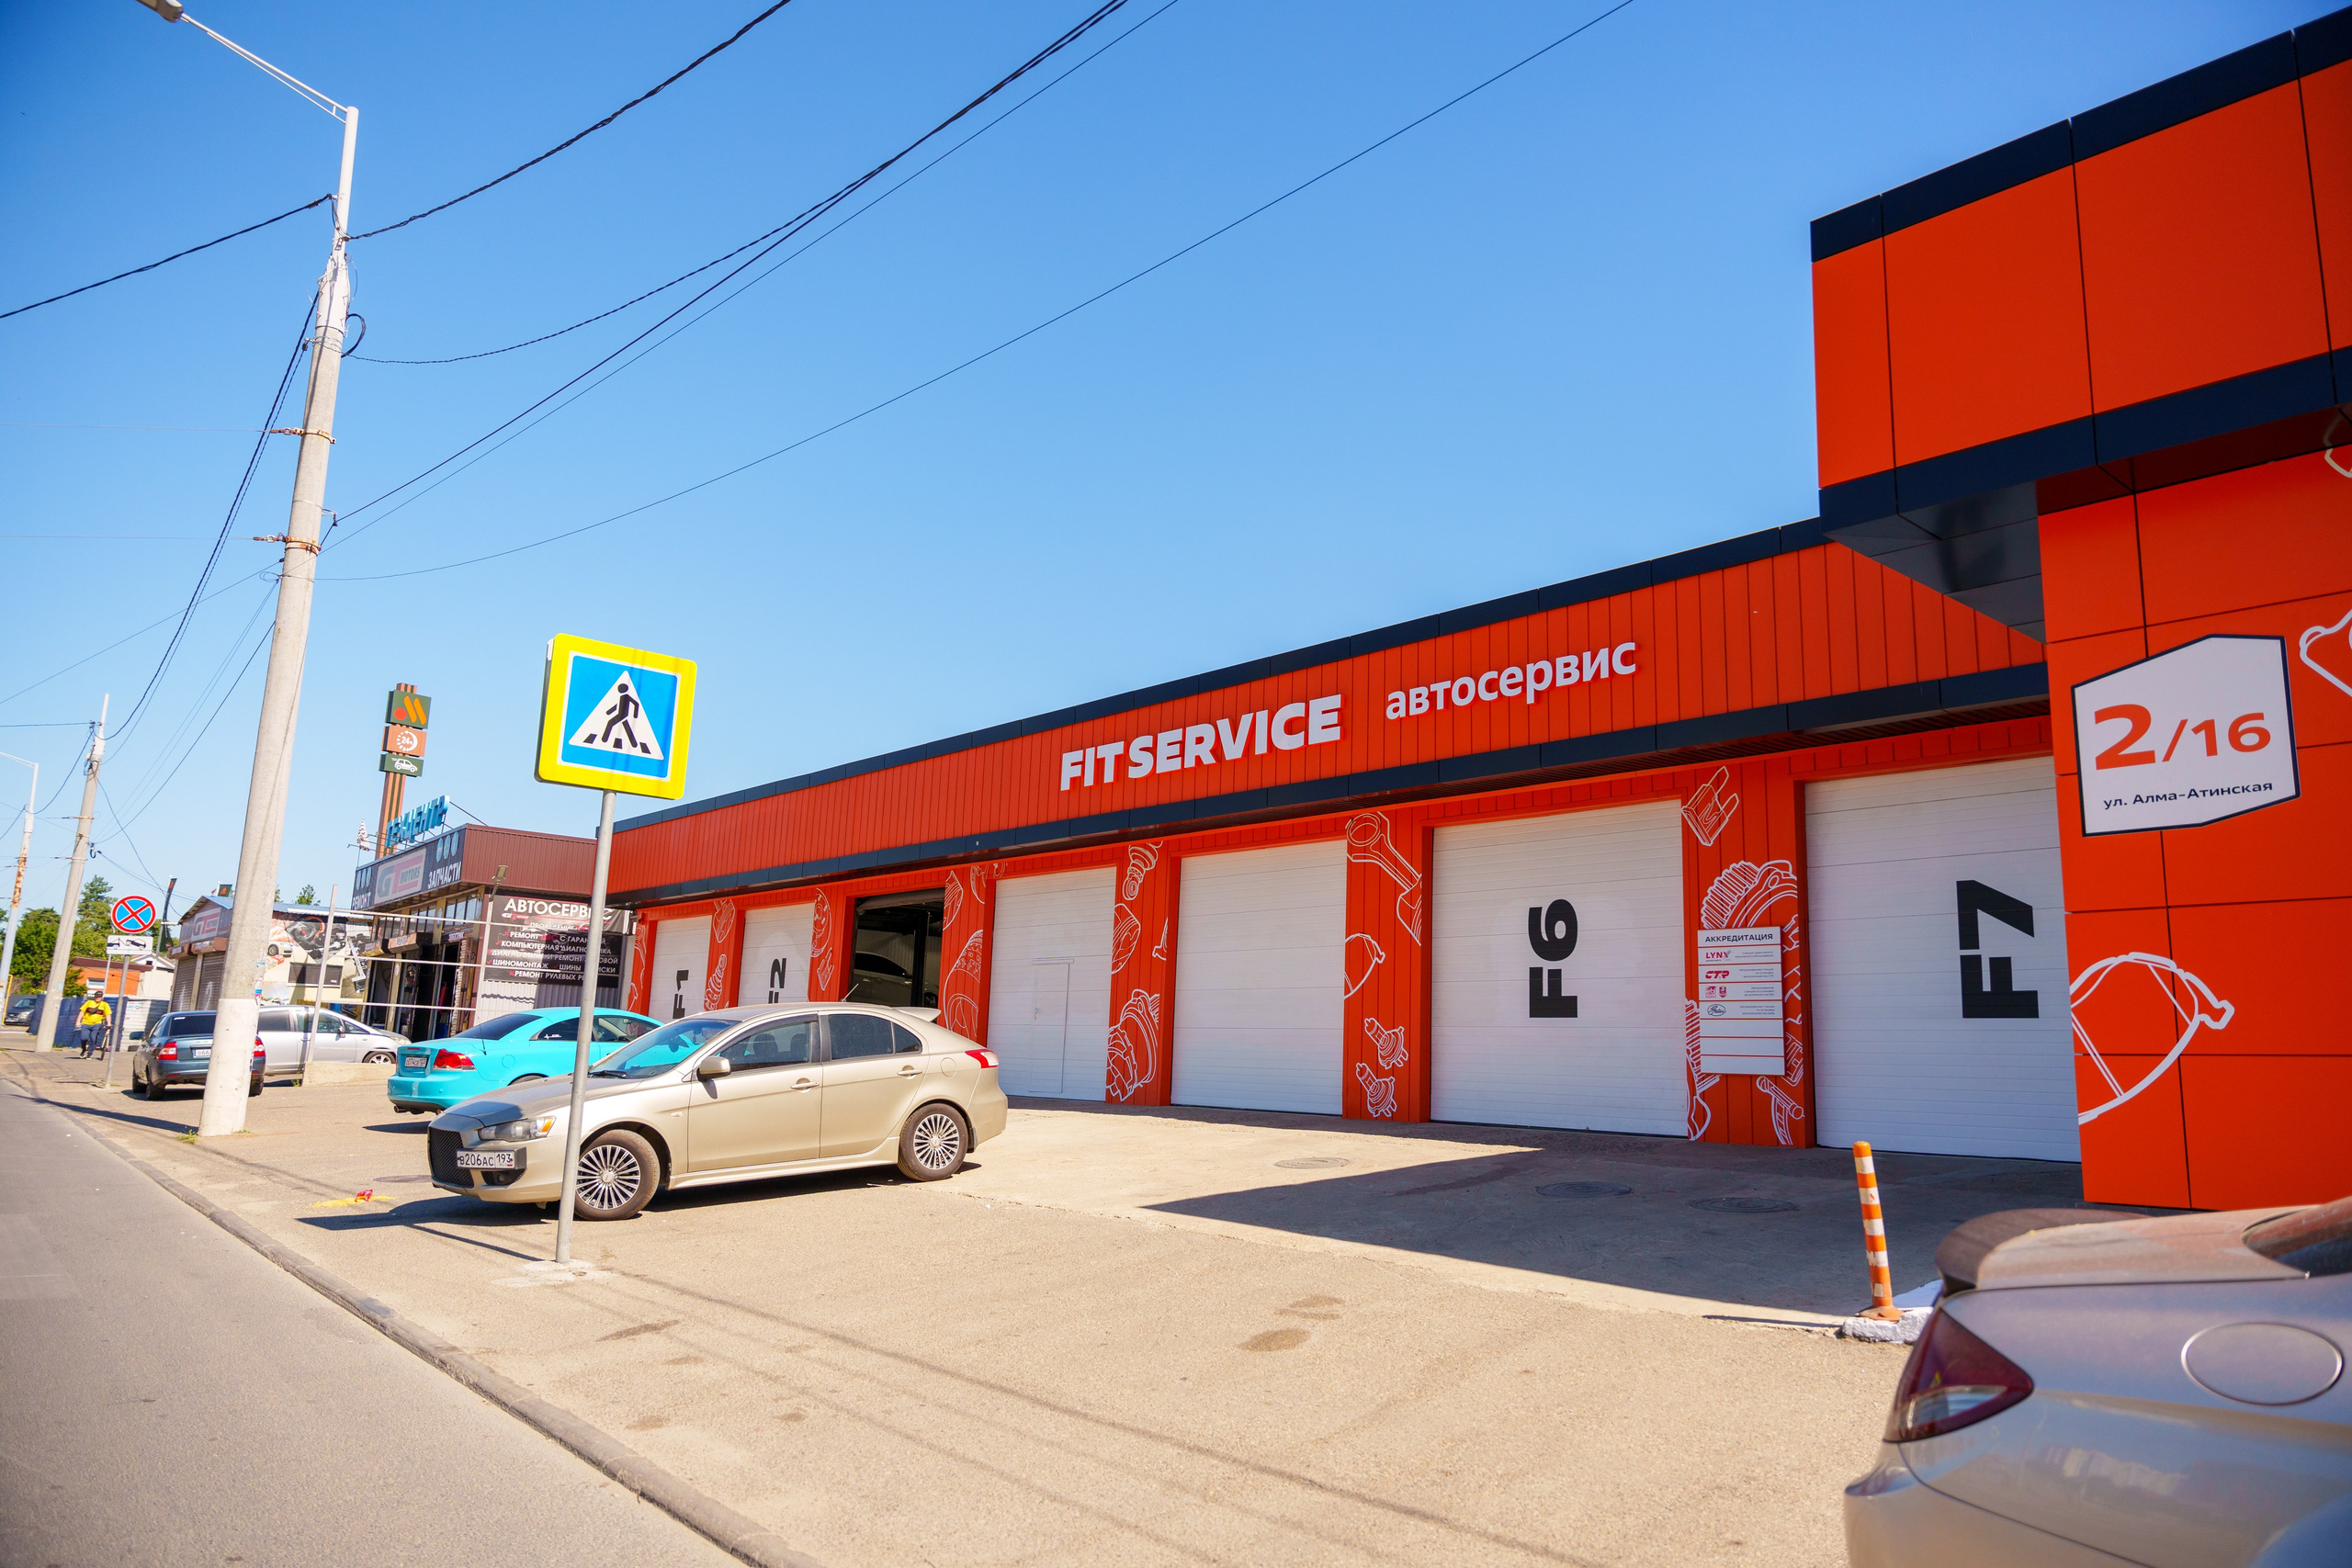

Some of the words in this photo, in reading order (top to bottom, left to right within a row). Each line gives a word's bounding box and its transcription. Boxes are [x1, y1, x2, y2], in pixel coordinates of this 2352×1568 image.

[1385, 641, 1637, 720] автосервис
[2094, 704, 2272, 771] 2/16
[2103, 796, 2128, 810] ул.
[2132, 782, 2274, 806] Алма-Атинская
[427, 861, 462, 890] ЗАПЧАСТИ
[503, 897, 613, 920] АВТОСЕРВС
[510, 931, 539, 940] РЕМОНТ
[567, 935, 606, 945] ГАРАНЙ
[1704, 933, 1773, 942] АККРЕДИТАЦИЯ
[501, 940, 560, 951] КОМПЬЮТЕРНАЯ
[560, 944, 612, 954] ДИАГНОИКА
[1705, 950, 1730, 959] LYNX
[1956, 879, 2040, 1019] F7
[492, 958, 549, 969] ШИНОМОНТАЖ
[1528, 898, 1578, 1019] F6
[514, 970, 544, 978] РЕМОНТ
[545, 972, 576, 981] РУЛЕВЫХ
[1705, 970, 1730, 979] CTR
[673, 970, 689, 1019] F1
[459, 1153, 494, 1167] В206АС
[495, 1153, 513, 1164] 193
